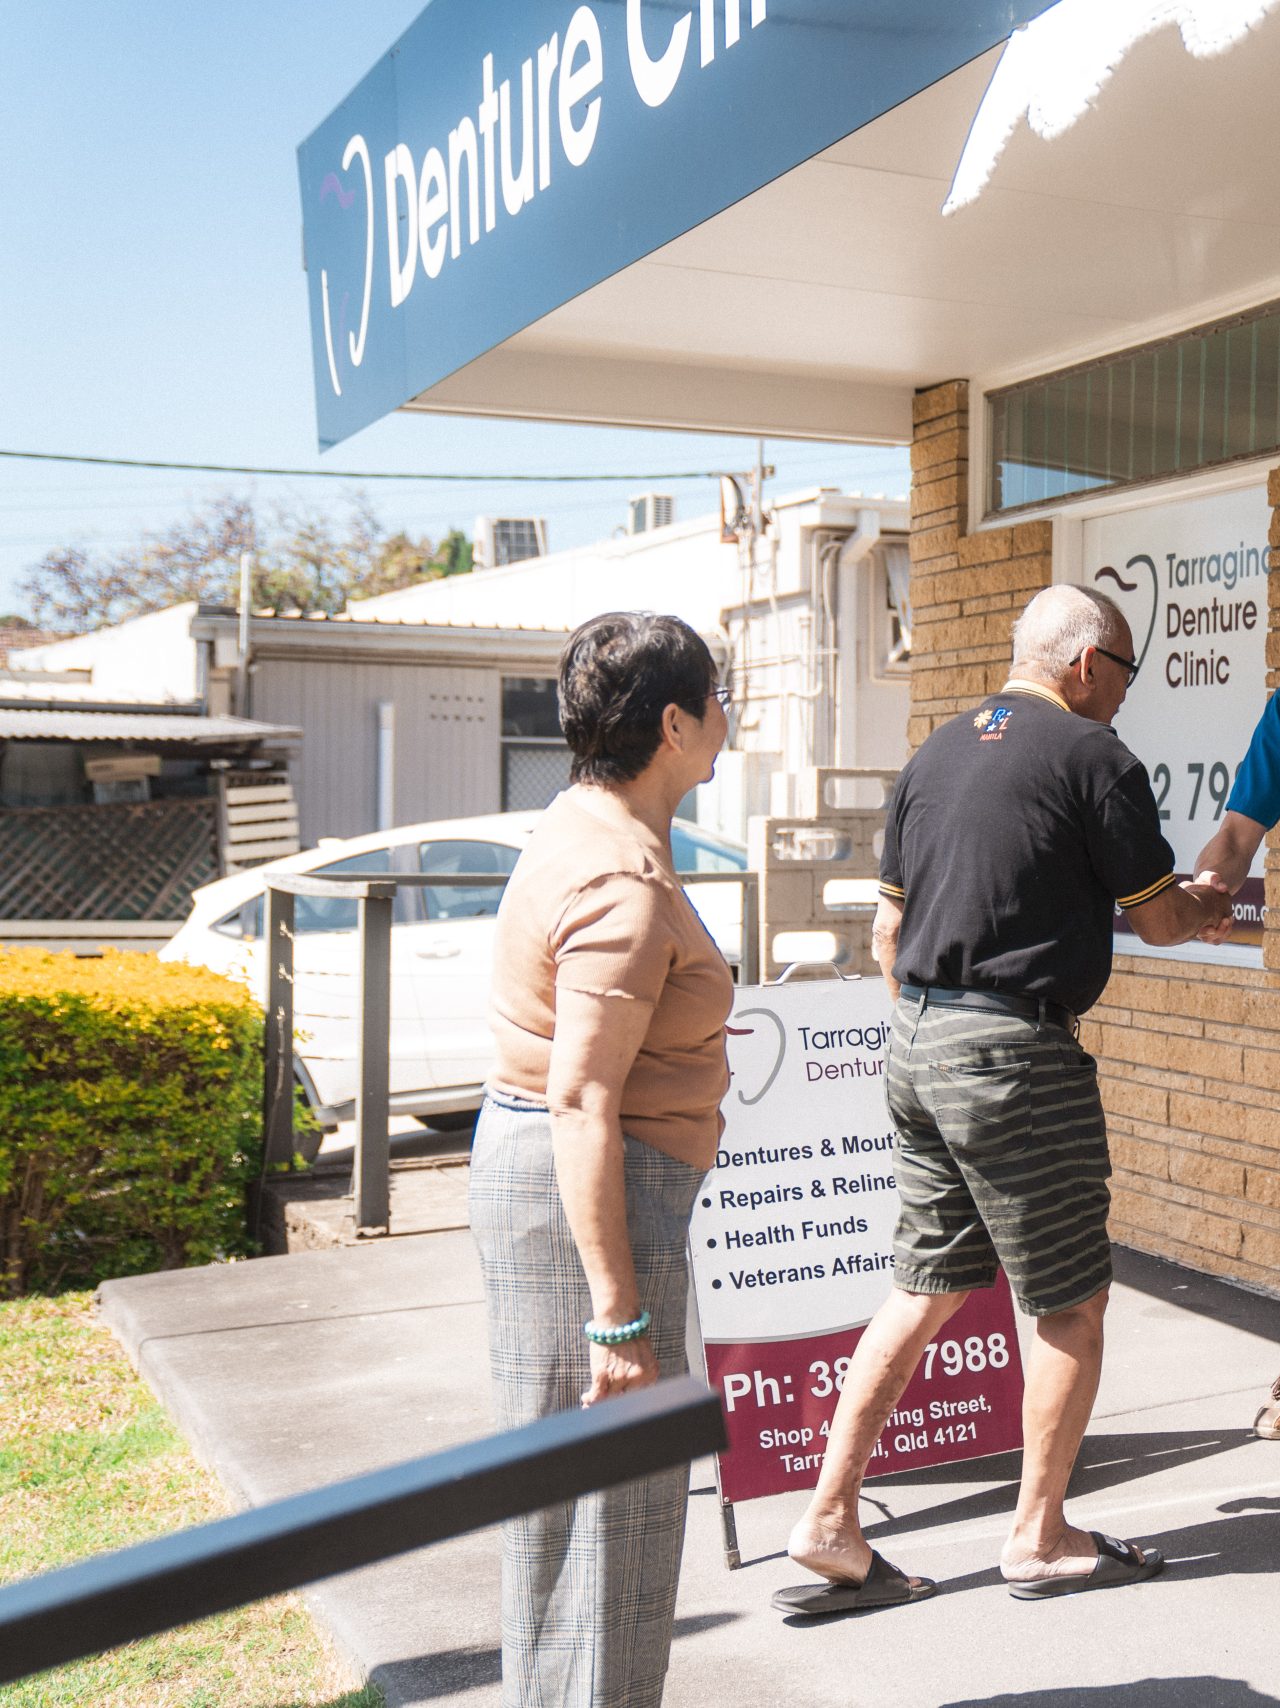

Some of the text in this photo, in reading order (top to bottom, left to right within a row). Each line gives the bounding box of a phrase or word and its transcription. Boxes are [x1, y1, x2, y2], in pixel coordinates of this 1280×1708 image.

[385, 6, 602, 308] Denture
[1167, 597, 1257, 639] Denture
[1166, 649, 1230, 688] Clinic
[716, 1131, 897, 1169] Dentures & Mout
[720, 1184, 803, 1210] Repairs
[810, 1179, 826, 1199] &
[725, 1215, 868, 1249] Health Funds
[729, 1252, 896, 1290] Veterans Affairs
[723, 1370, 794, 1413] Ph:
[924, 1332, 1010, 1381] 7988
[759, 1427, 814, 1450] Shop
[929, 1394, 992, 1420] Street,
[894, 1431, 929, 1453] Qld
[934, 1422, 978, 1446] 4121
